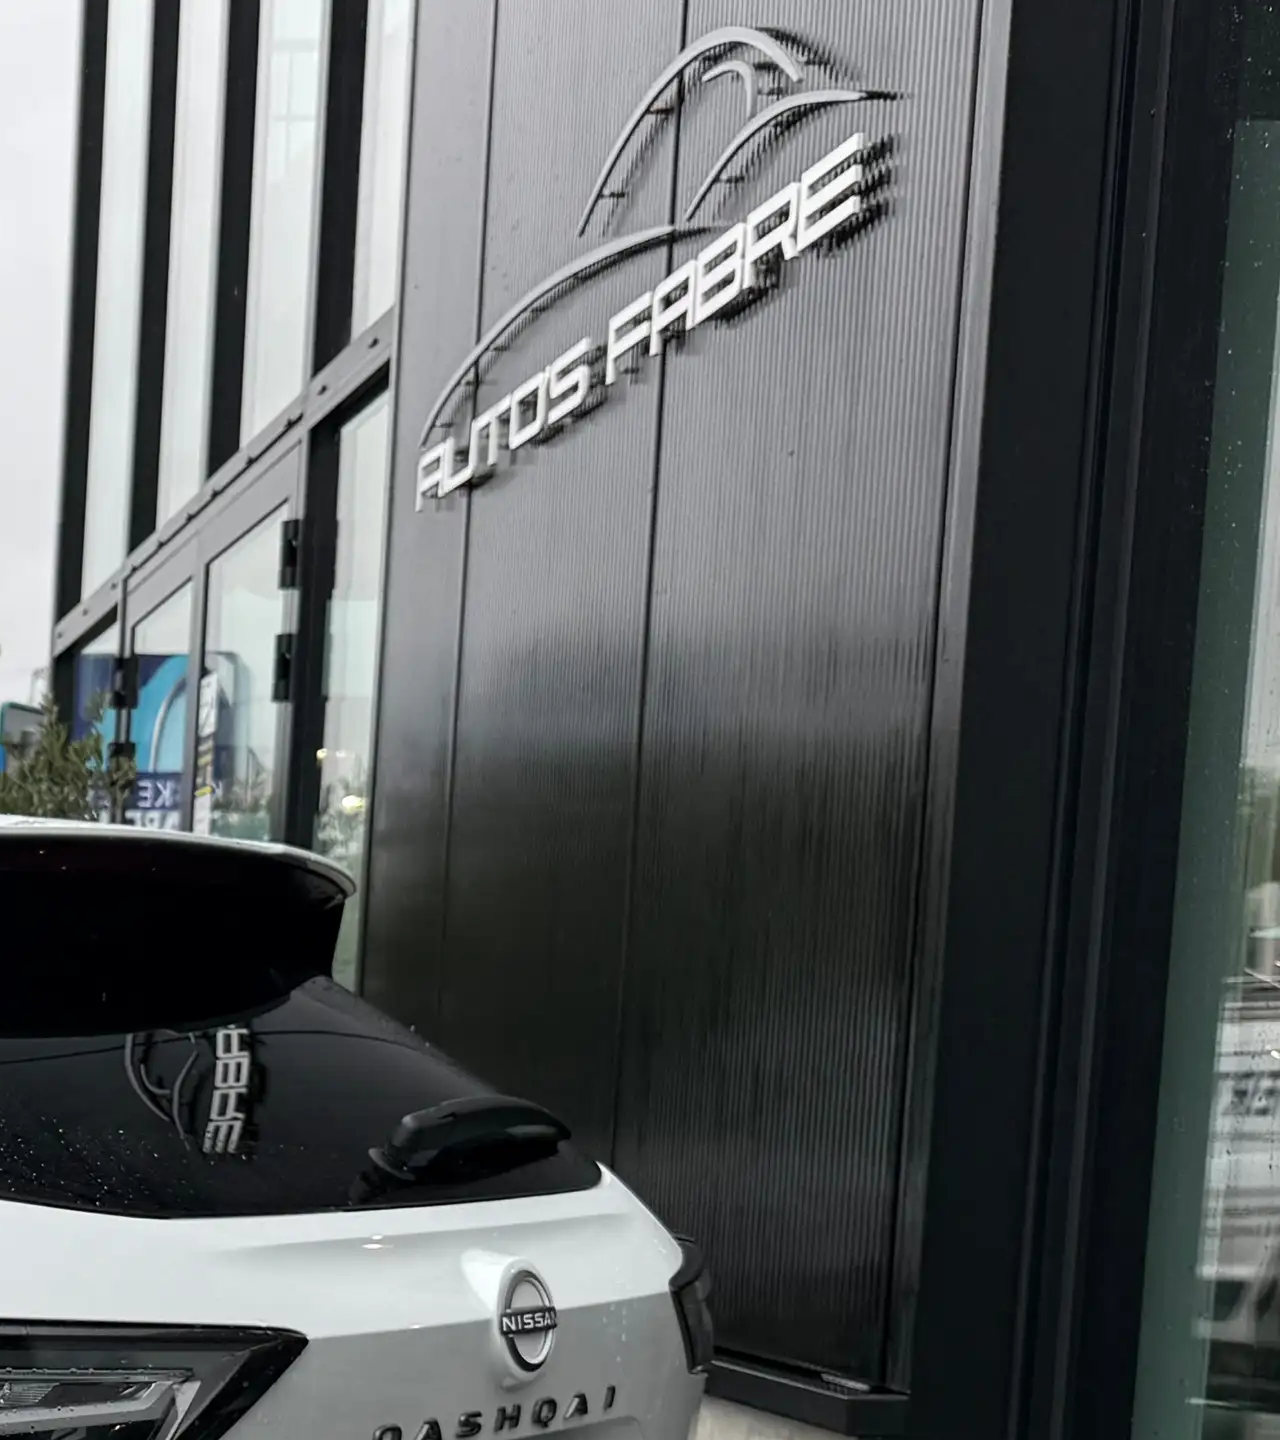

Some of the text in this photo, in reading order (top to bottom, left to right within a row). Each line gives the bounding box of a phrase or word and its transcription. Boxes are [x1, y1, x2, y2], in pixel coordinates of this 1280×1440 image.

[415, 132, 865, 512] AUTOS FABRE
[501, 1309, 557, 1333] NISSAN
